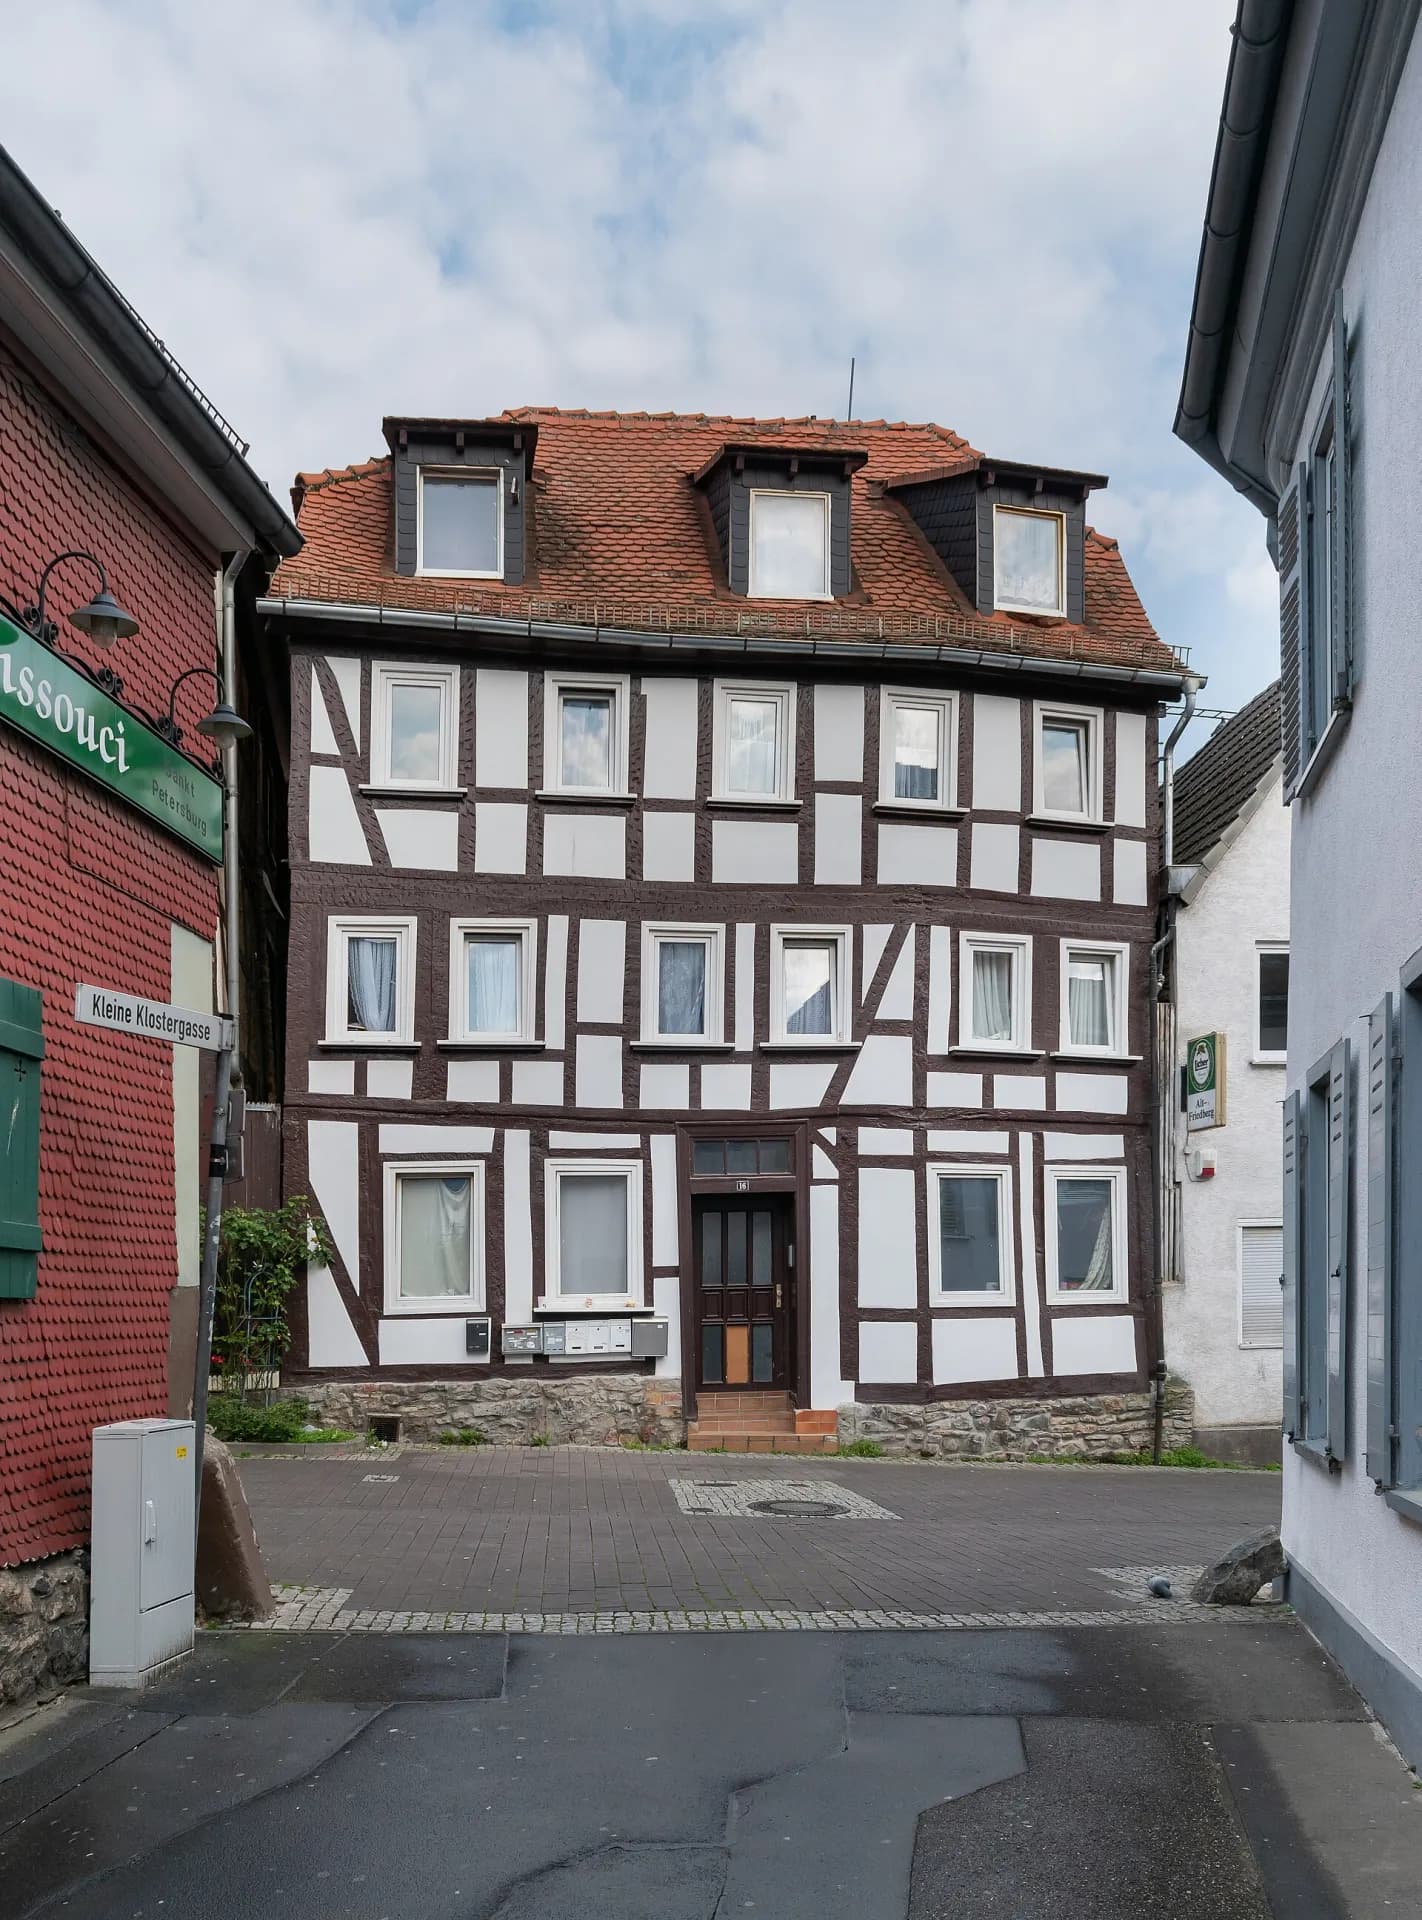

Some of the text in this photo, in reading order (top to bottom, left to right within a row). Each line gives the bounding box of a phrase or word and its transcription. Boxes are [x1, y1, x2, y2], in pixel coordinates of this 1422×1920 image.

[152, 779, 207, 836] Petersburg
[92, 993, 211, 1041] Kleine Klostergasse
[1188, 1109, 1215, 1122] Friedberg
[739, 1182, 747, 1190] 16
